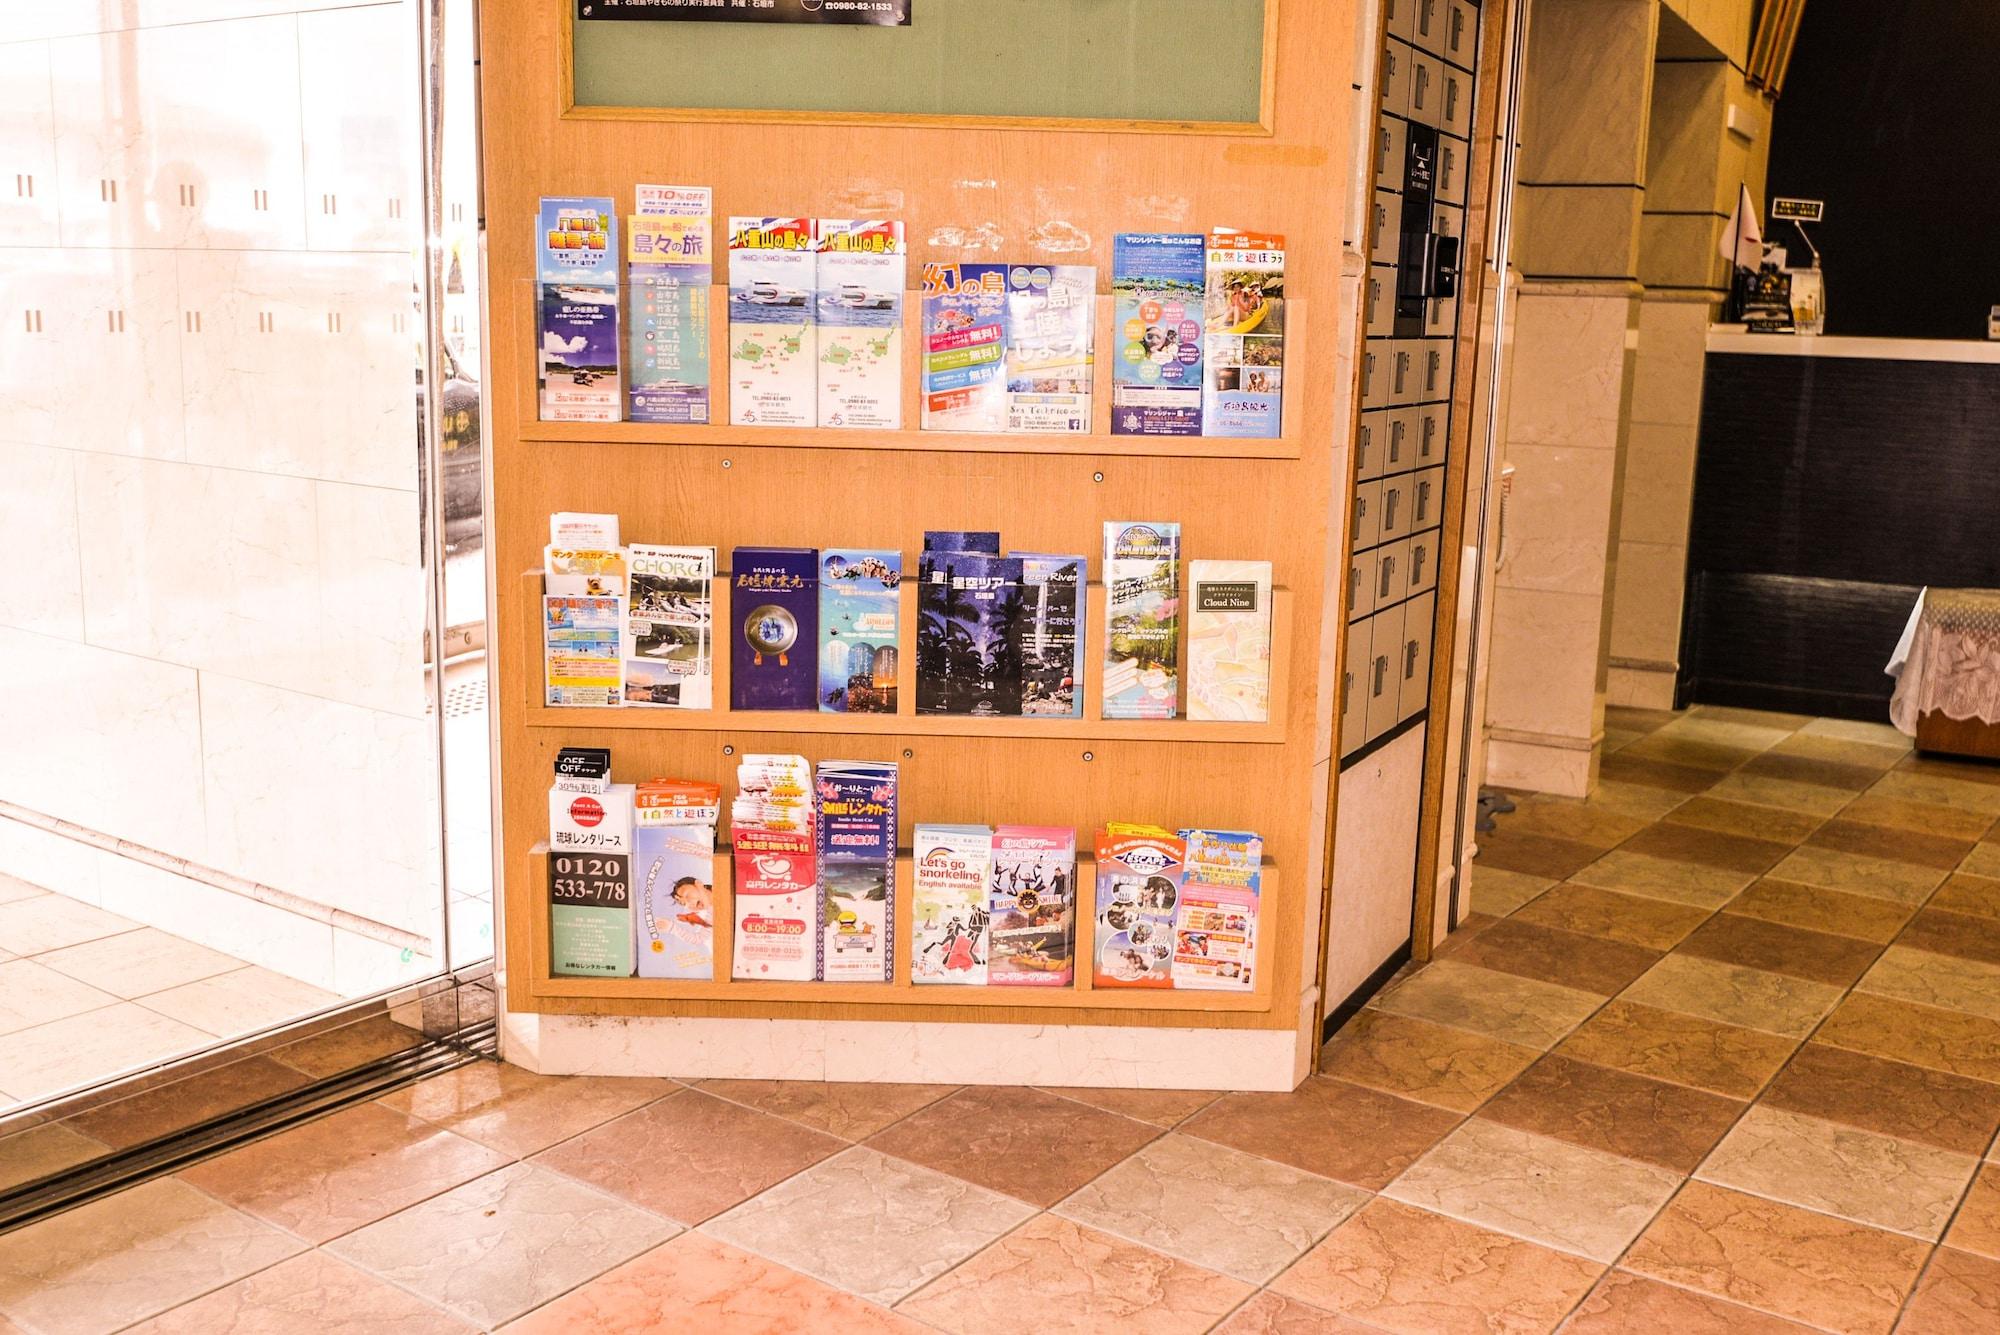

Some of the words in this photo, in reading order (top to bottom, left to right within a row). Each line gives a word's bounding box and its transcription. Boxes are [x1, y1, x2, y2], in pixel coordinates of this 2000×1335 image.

[634, 234, 703, 255] 島々の旅
[735, 229, 809, 250] 八重山の島々
[823, 232, 897, 253] 八重山の島々
[924, 263, 1005, 296] 幻の島
[952, 576, 1017, 590] 星空ツアー
[1204, 598, 1228, 607] Cloud
[1230, 598, 1250, 607] Nine
[560, 764, 581, 773] OFF
[556, 831, 622, 846] 琉球レンタリース
[556, 858, 620, 876] 0120
[920, 856, 947, 869] Let's
[951, 859, 966, 870] go
[1126, 854, 1167, 866] ESCAPE
[919, 868, 983, 882] snorkeling.
[554, 879, 626, 901] 533-778
[918, 880, 948, 889] English
[948, 881, 982, 890] available
